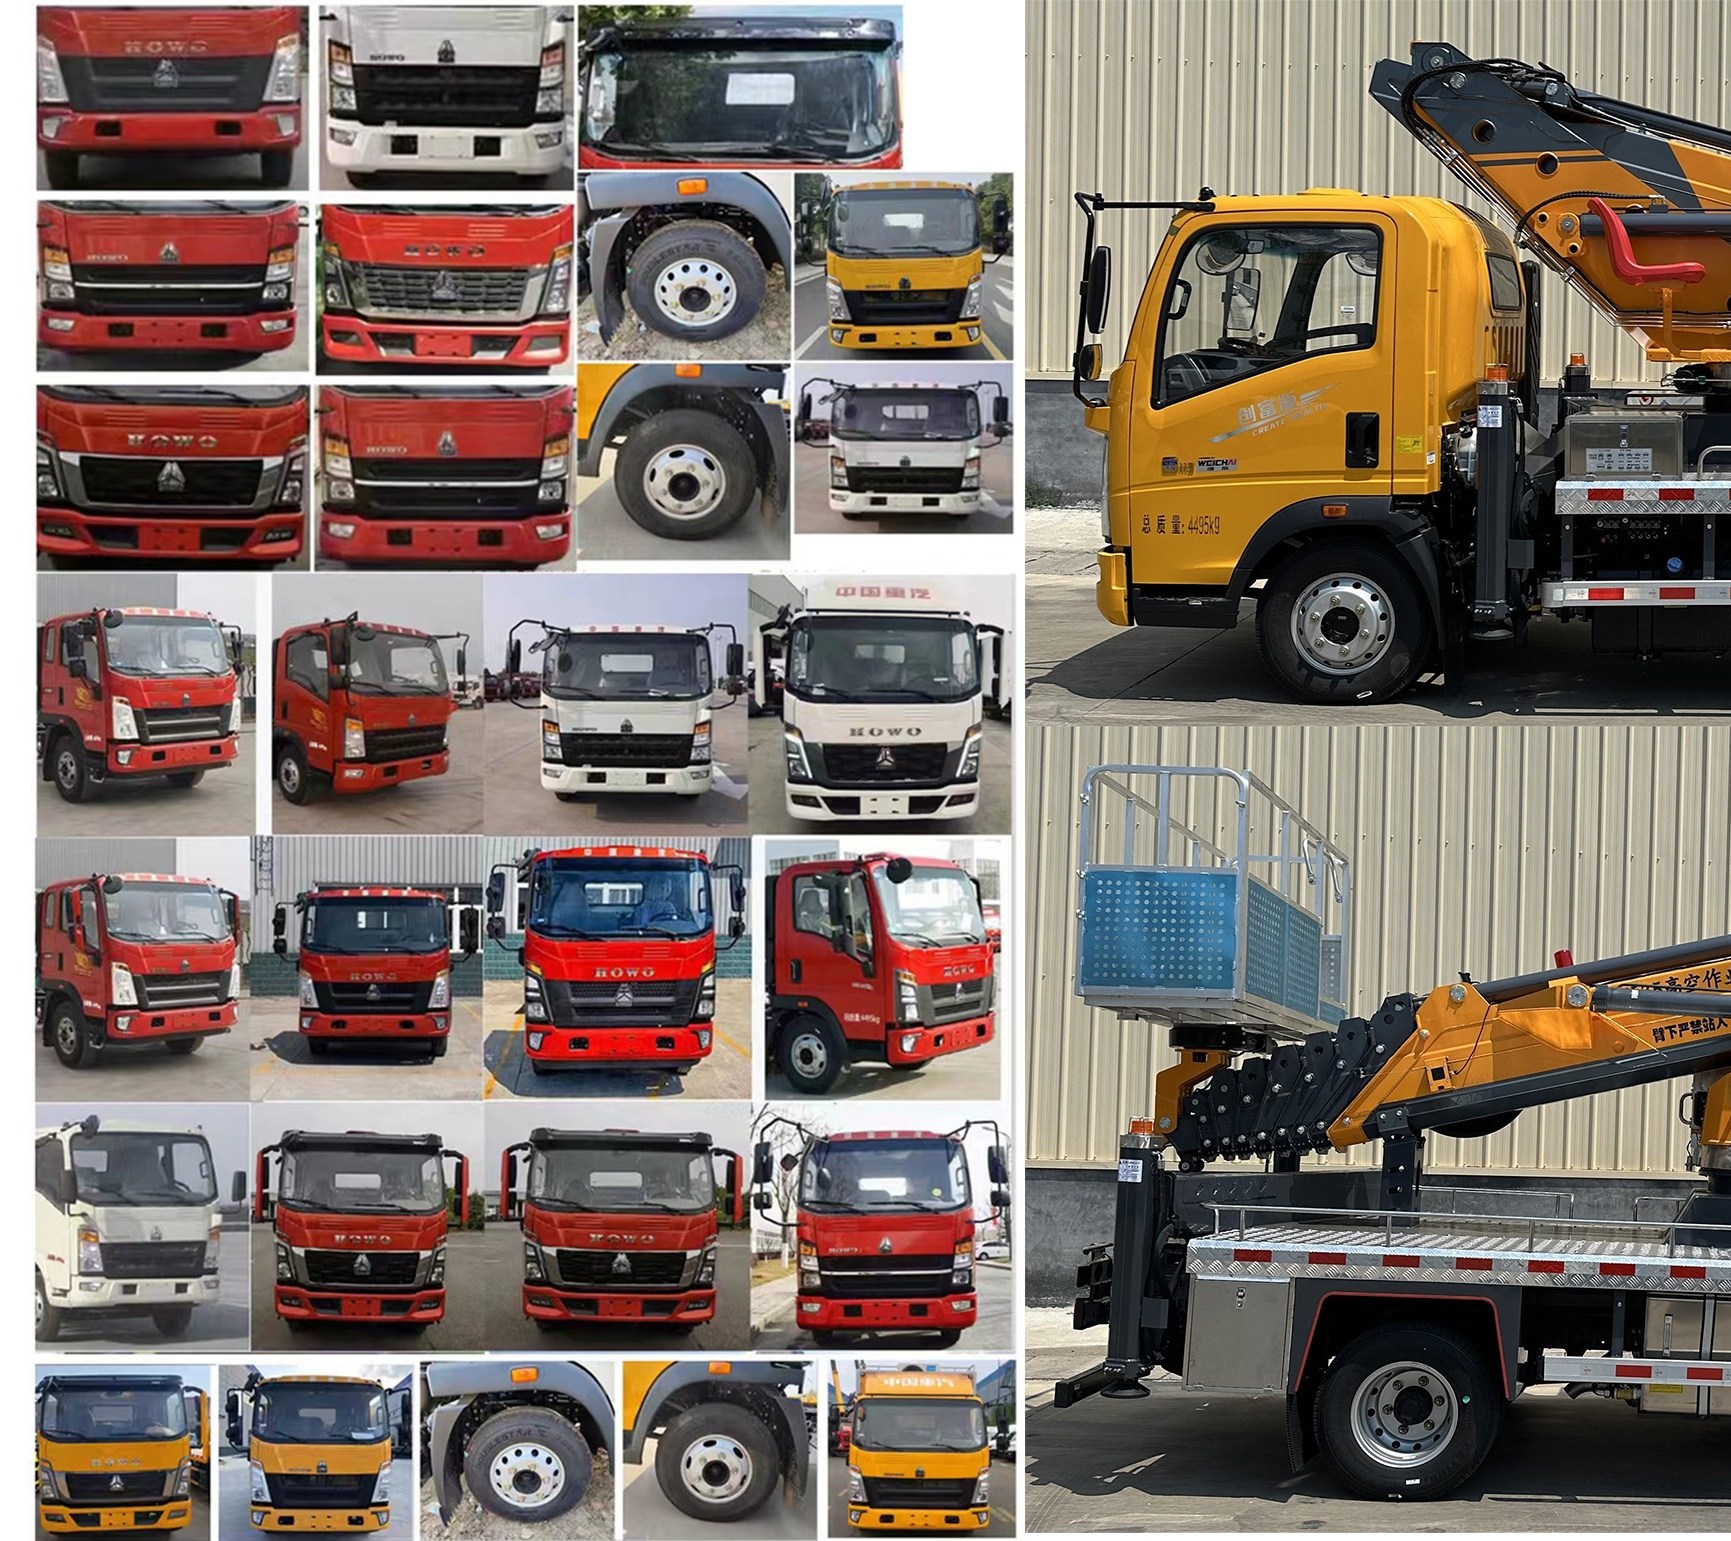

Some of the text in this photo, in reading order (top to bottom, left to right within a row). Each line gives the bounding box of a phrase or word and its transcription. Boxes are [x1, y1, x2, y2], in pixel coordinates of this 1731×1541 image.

[127, 433, 218, 448] HOWO
[1197, 459, 1237, 468] WEICHAI
[1187, 515, 1220, 535] 4495kg
[849, 727, 922, 737] HOWO
[594, 966, 655, 978] HOWO
[334, 1234, 391, 1244] HOWO
[589, 1233, 655, 1244] HOWO
